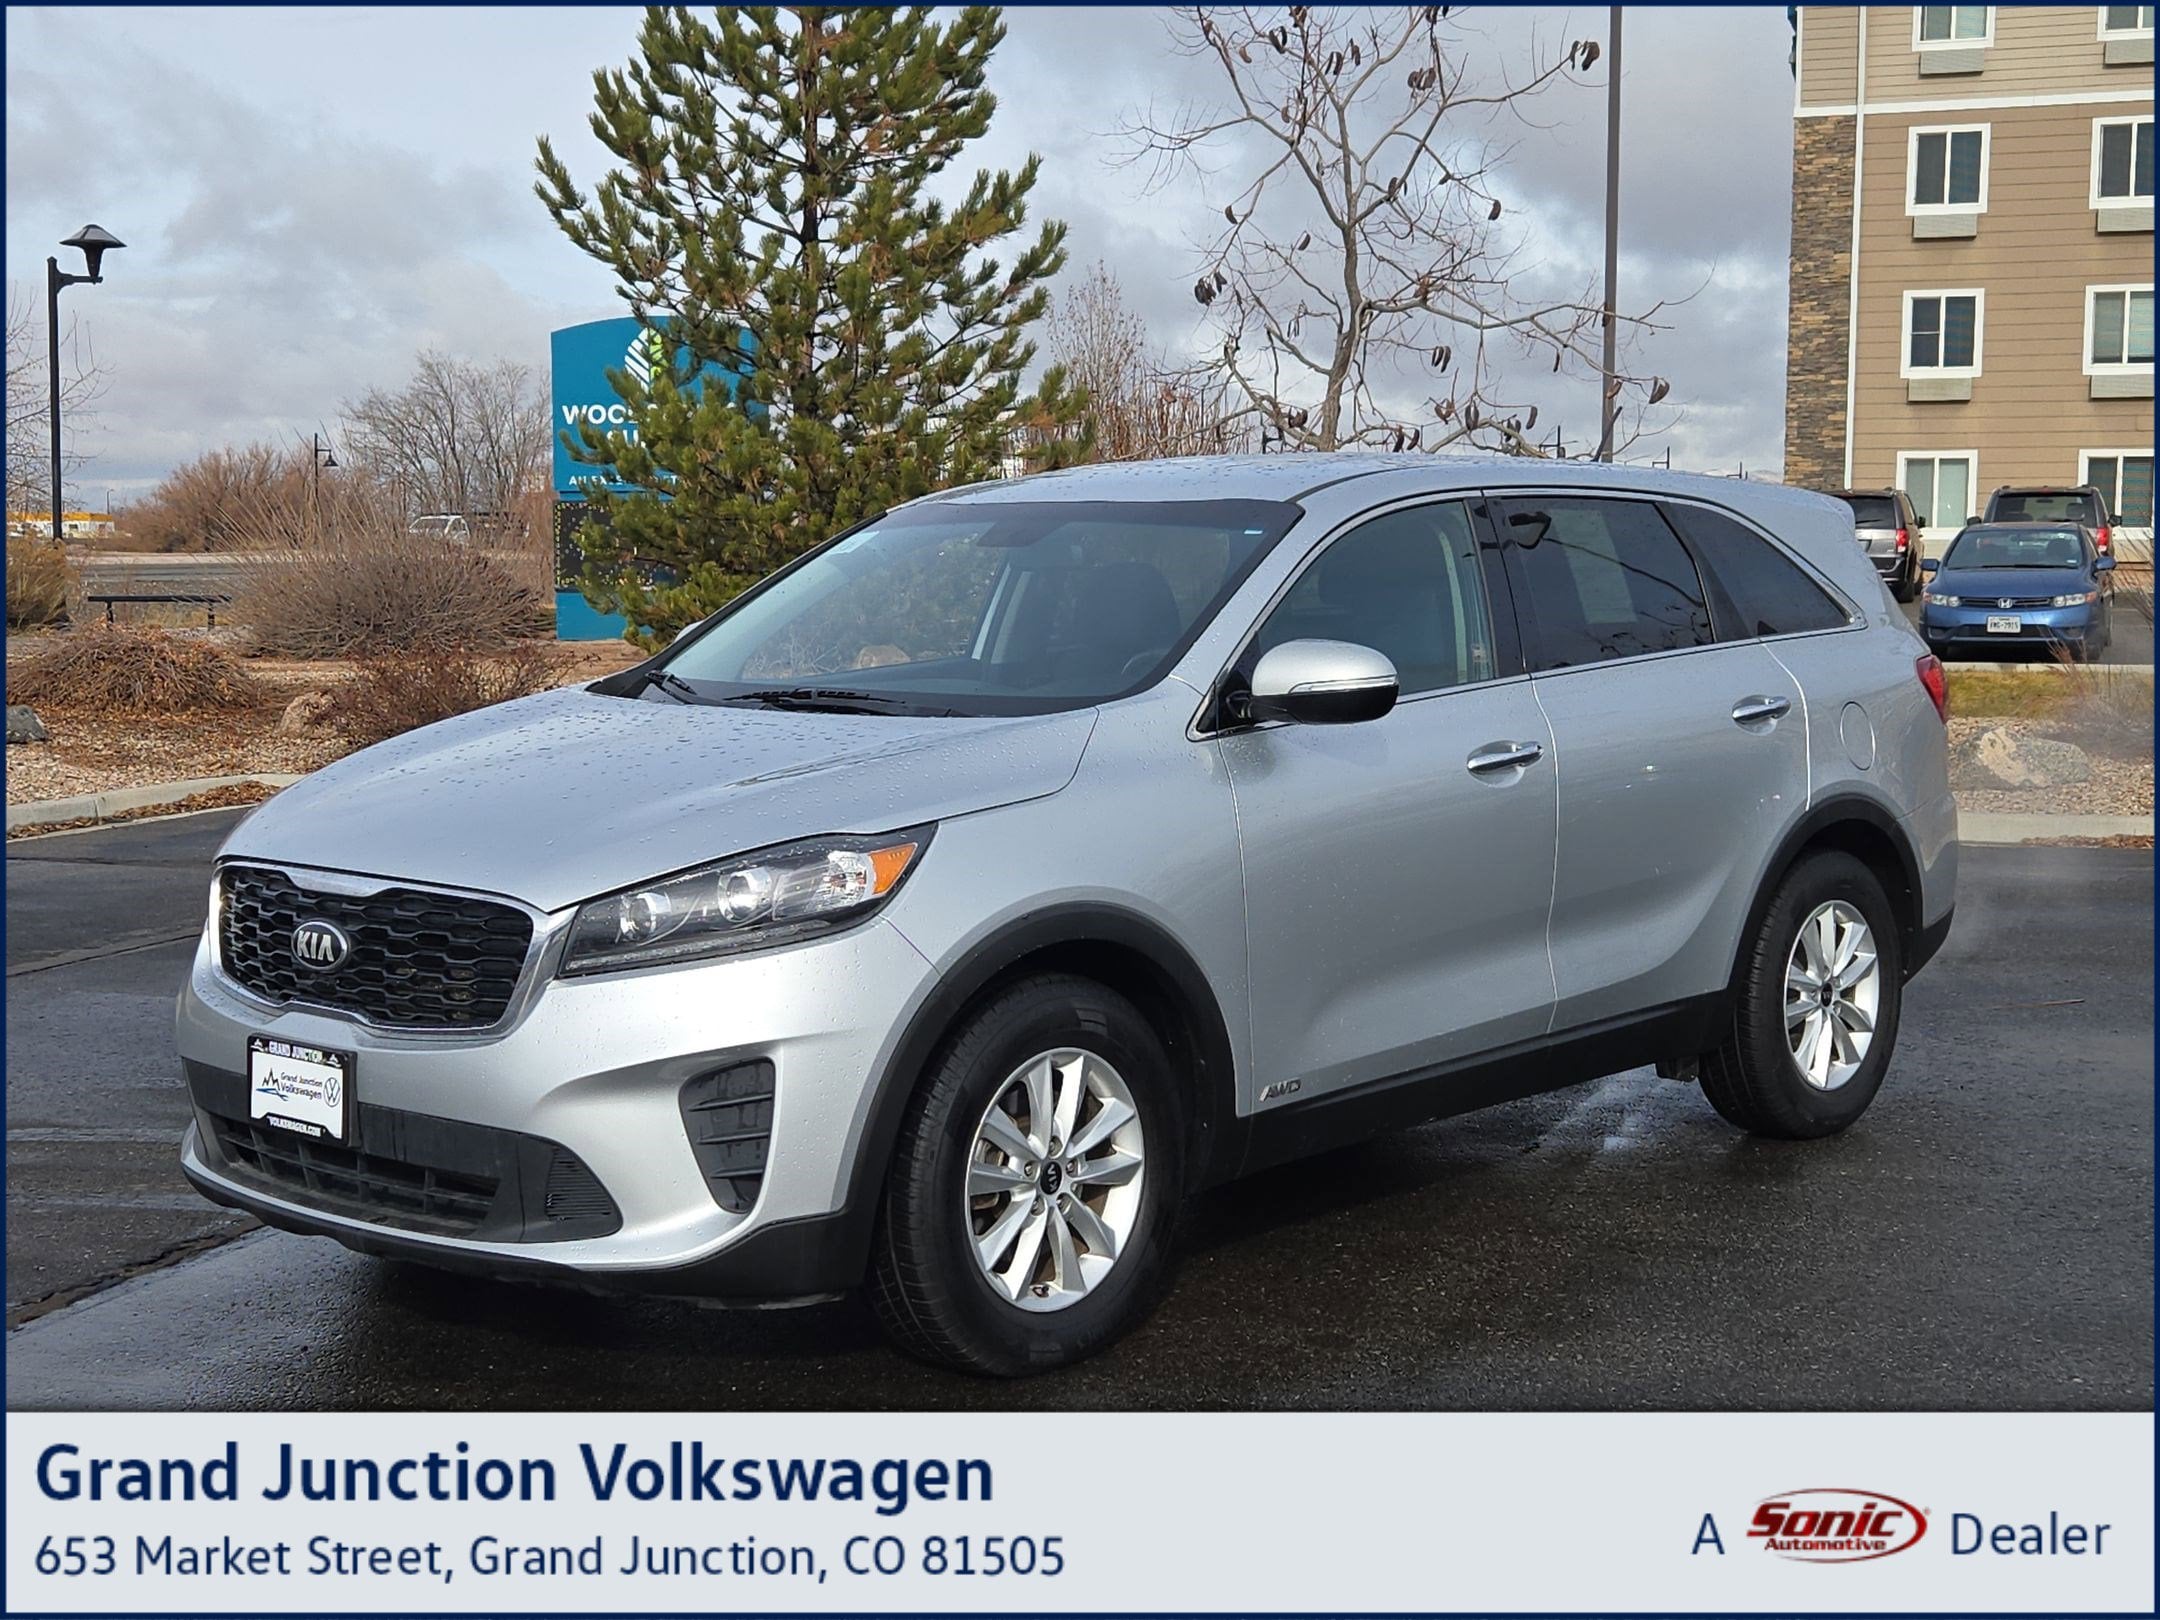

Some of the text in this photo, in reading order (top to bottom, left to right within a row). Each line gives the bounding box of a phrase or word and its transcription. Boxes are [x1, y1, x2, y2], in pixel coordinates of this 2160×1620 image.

[296, 929, 335, 962] KIA
[280, 1071, 322, 1087] Grand Junction
[280, 1081, 322, 1101] Volkswagen
[1259, 1079, 1301, 1103] AWD
